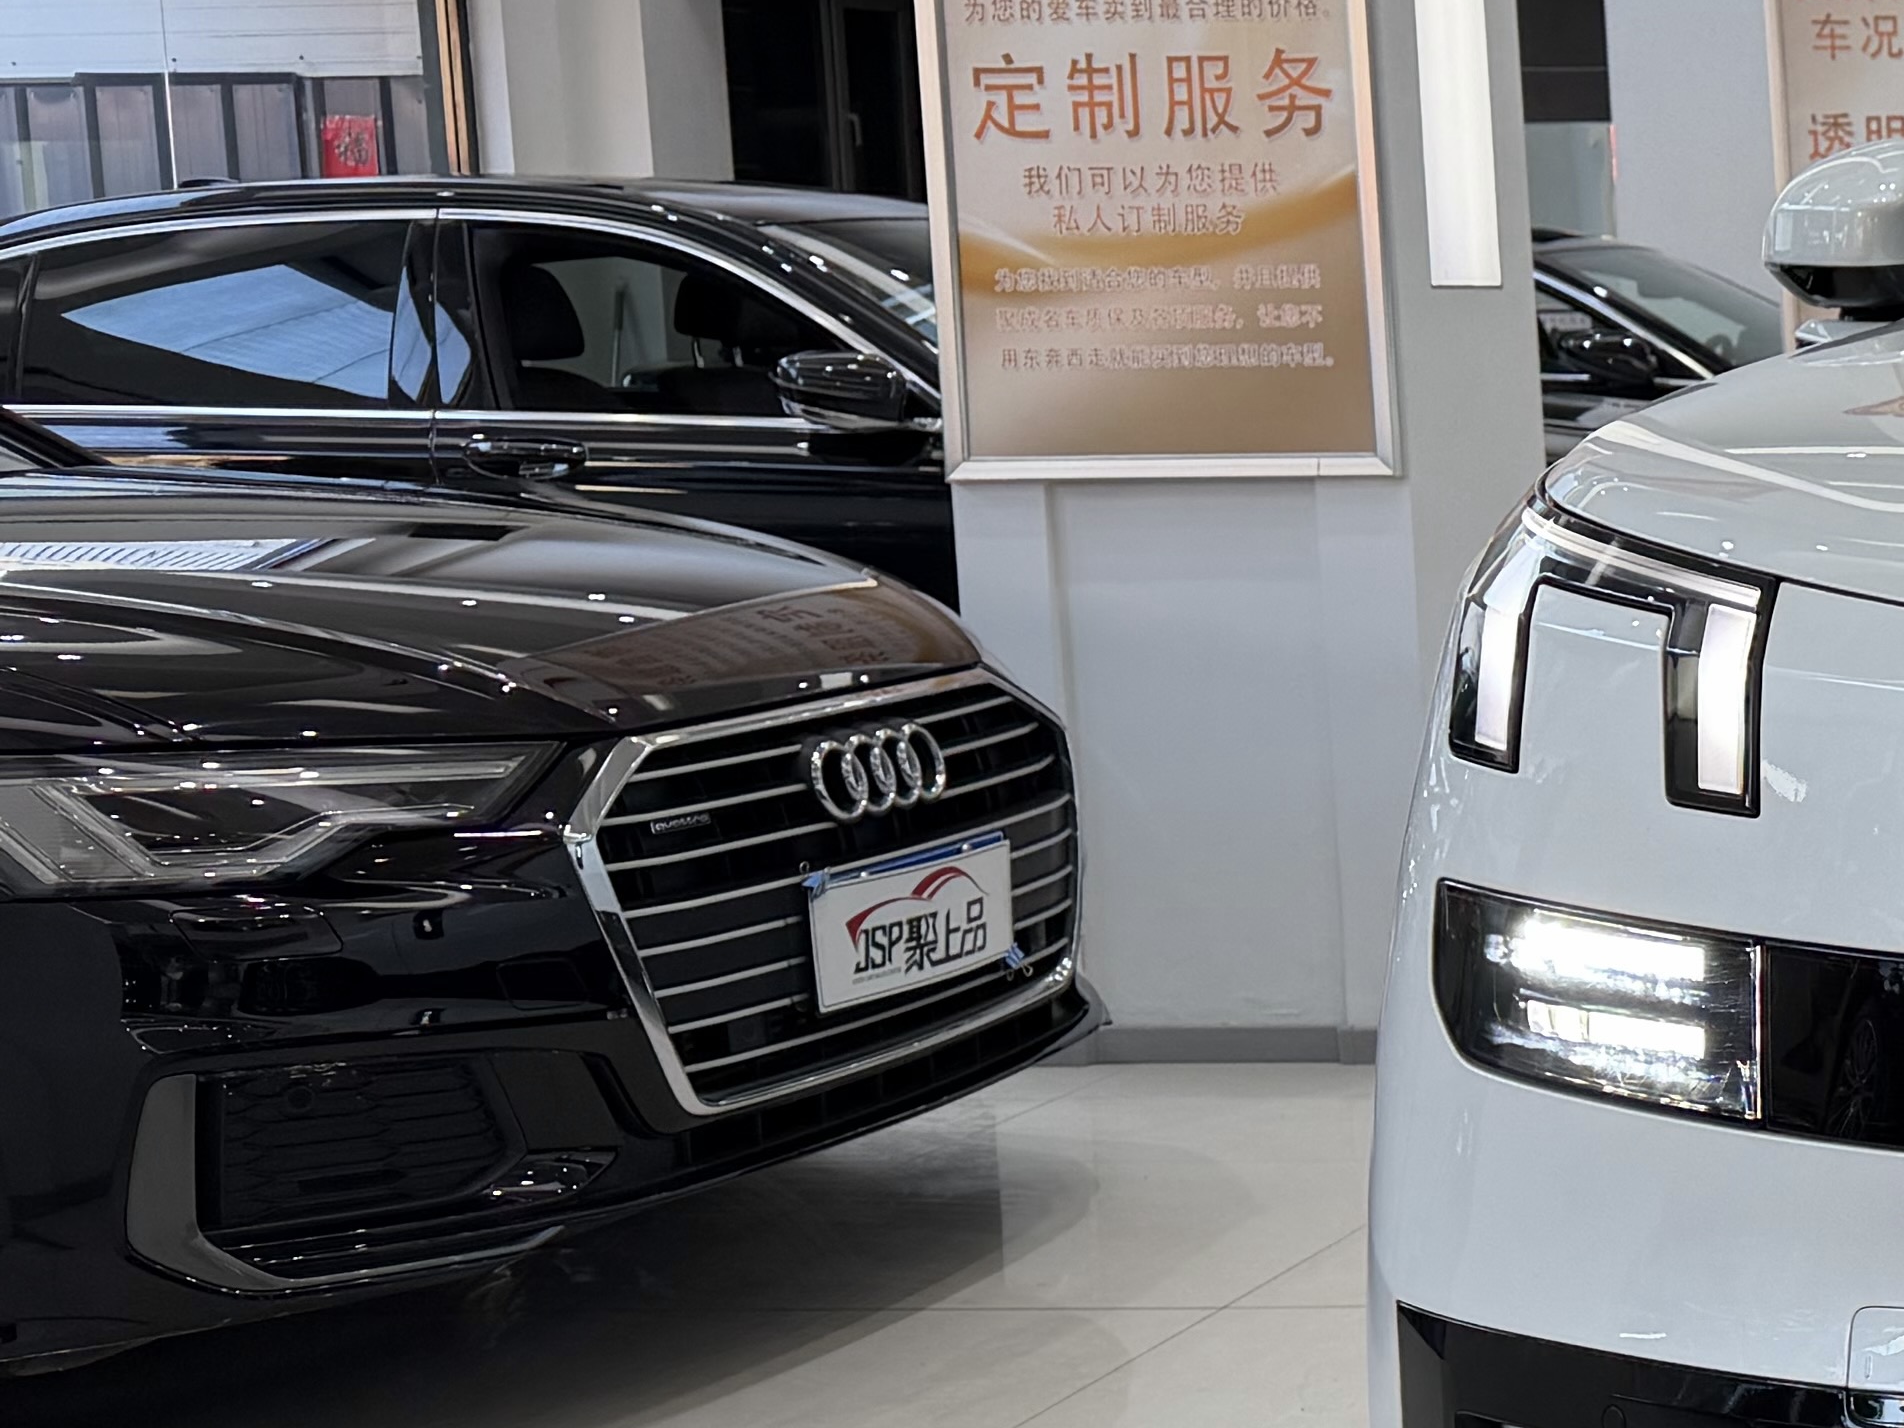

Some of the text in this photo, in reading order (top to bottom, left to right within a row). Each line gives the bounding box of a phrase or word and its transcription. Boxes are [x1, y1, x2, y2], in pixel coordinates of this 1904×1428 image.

[972, 47, 1333, 140] 定制服务
[1023, 162, 1280, 197] 我们可以为您提供
[1053, 202, 1244, 235] 私人订制服务
